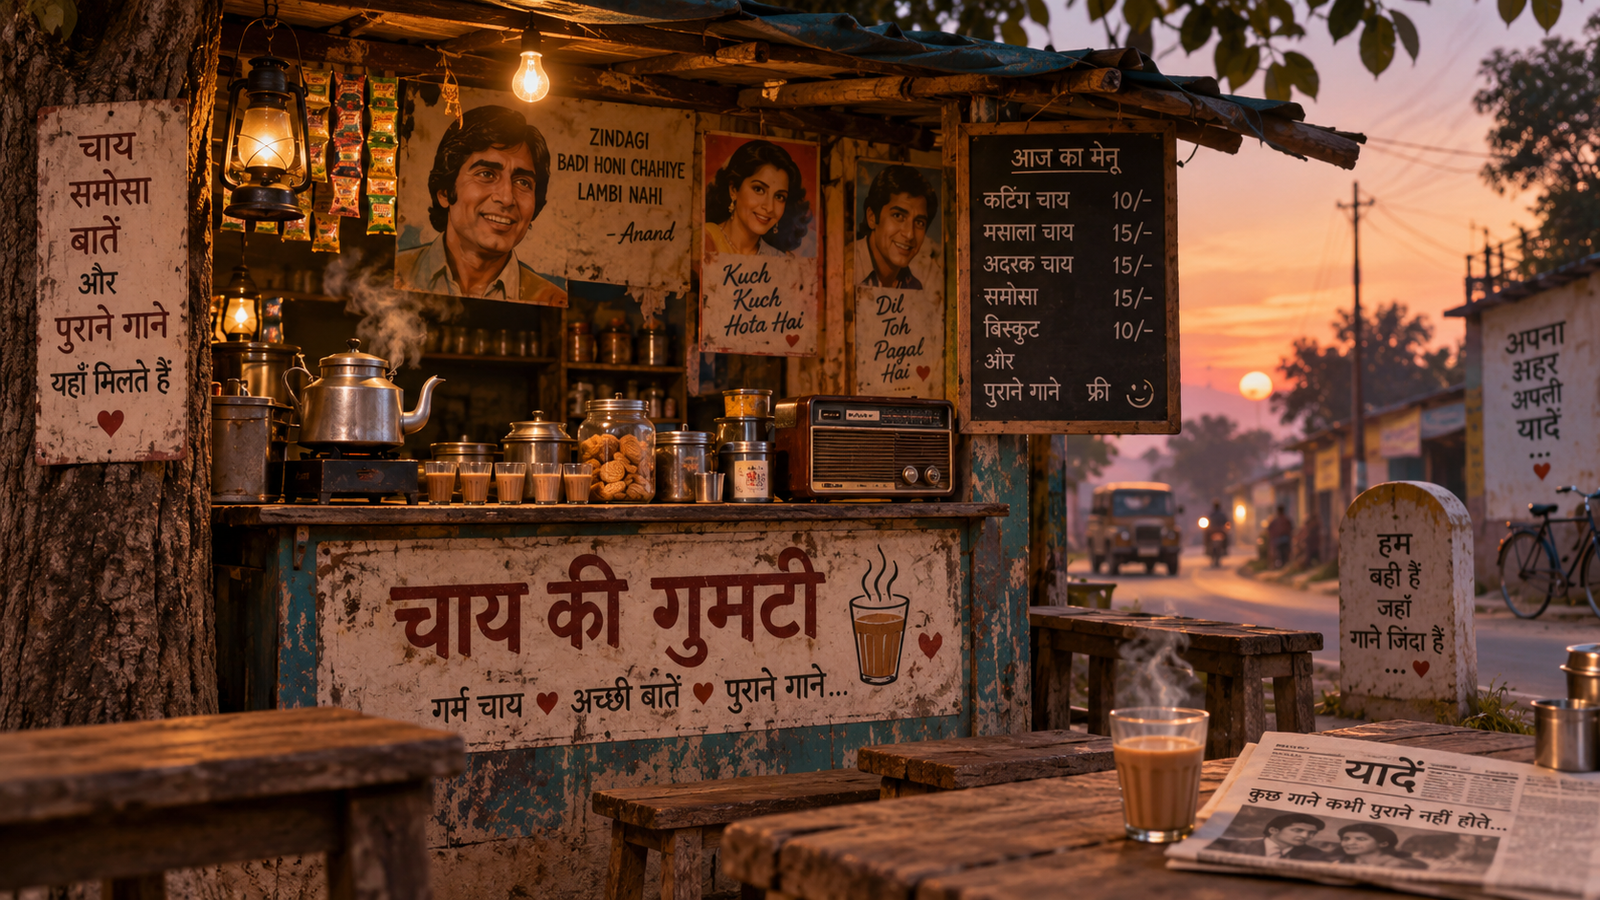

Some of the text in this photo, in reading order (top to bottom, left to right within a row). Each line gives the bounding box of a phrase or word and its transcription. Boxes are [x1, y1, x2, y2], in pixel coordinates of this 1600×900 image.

[77, 132, 137, 161] चाय
[589, 127, 649, 150] ZINDAGI
[557, 153, 686, 180] BADI HONI CHAHIYE
[1010, 140, 1122, 175] आज का मेनू
[68, 169, 152, 208] समोसा
[577, 182, 663, 206] LAMBI NAHI
[983, 185, 1152, 212] कटिंग चाय 10/-
[69, 215, 121, 254] बातें
[983, 221, 1152, 245] मसाला चाय 15/-
[78, 262, 118, 295] और
[722, 262, 771, 287] Kuch
[983, 254, 1152, 277] अदरक चाय 15/-
[733, 287, 782, 312] Kuch
[875, 293, 905, 316] Dil
[983, 282, 1153, 310] समोसा 15/-
[55, 301, 169, 354] पुराने गाने
[724, 311, 804, 337] Hota Hai
[881, 316, 911, 337] Toh
[983, 313, 1153, 345] बिस्कुट 10/-
[1505, 320, 1567, 354] अपना
[873, 337, 925, 364] Pagal
[984, 347, 1015, 370] और
[50, 356, 172, 399] यहाँ मिलते हैं
[881, 364, 910, 383] Hai
[983, 376, 1111, 408] पुराने गाने फ्री
[1516, 407, 1562, 441] यादें
[1376, 533, 1413, 559] हम
[1407, 559, 1422, 590] हैं
[389, 547, 826, 668] चाय की गुमटी
[1349, 623, 1445, 655] गाने जिंदा हैं
[431, 686, 525, 724] गर्म चाय
[570, 672, 683, 714] अच्छी बातें
[724, 666, 778, 715] पुराने
[1344, 756, 1425, 794] यादें
[1247, 787, 1284, 804] कुछ
[1287, 791, 1322, 808] गाने
[1325, 796, 1366, 814] कभी
[1369, 803, 1414, 821] पुराने
[1419, 809, 1453, 826] नहीं
